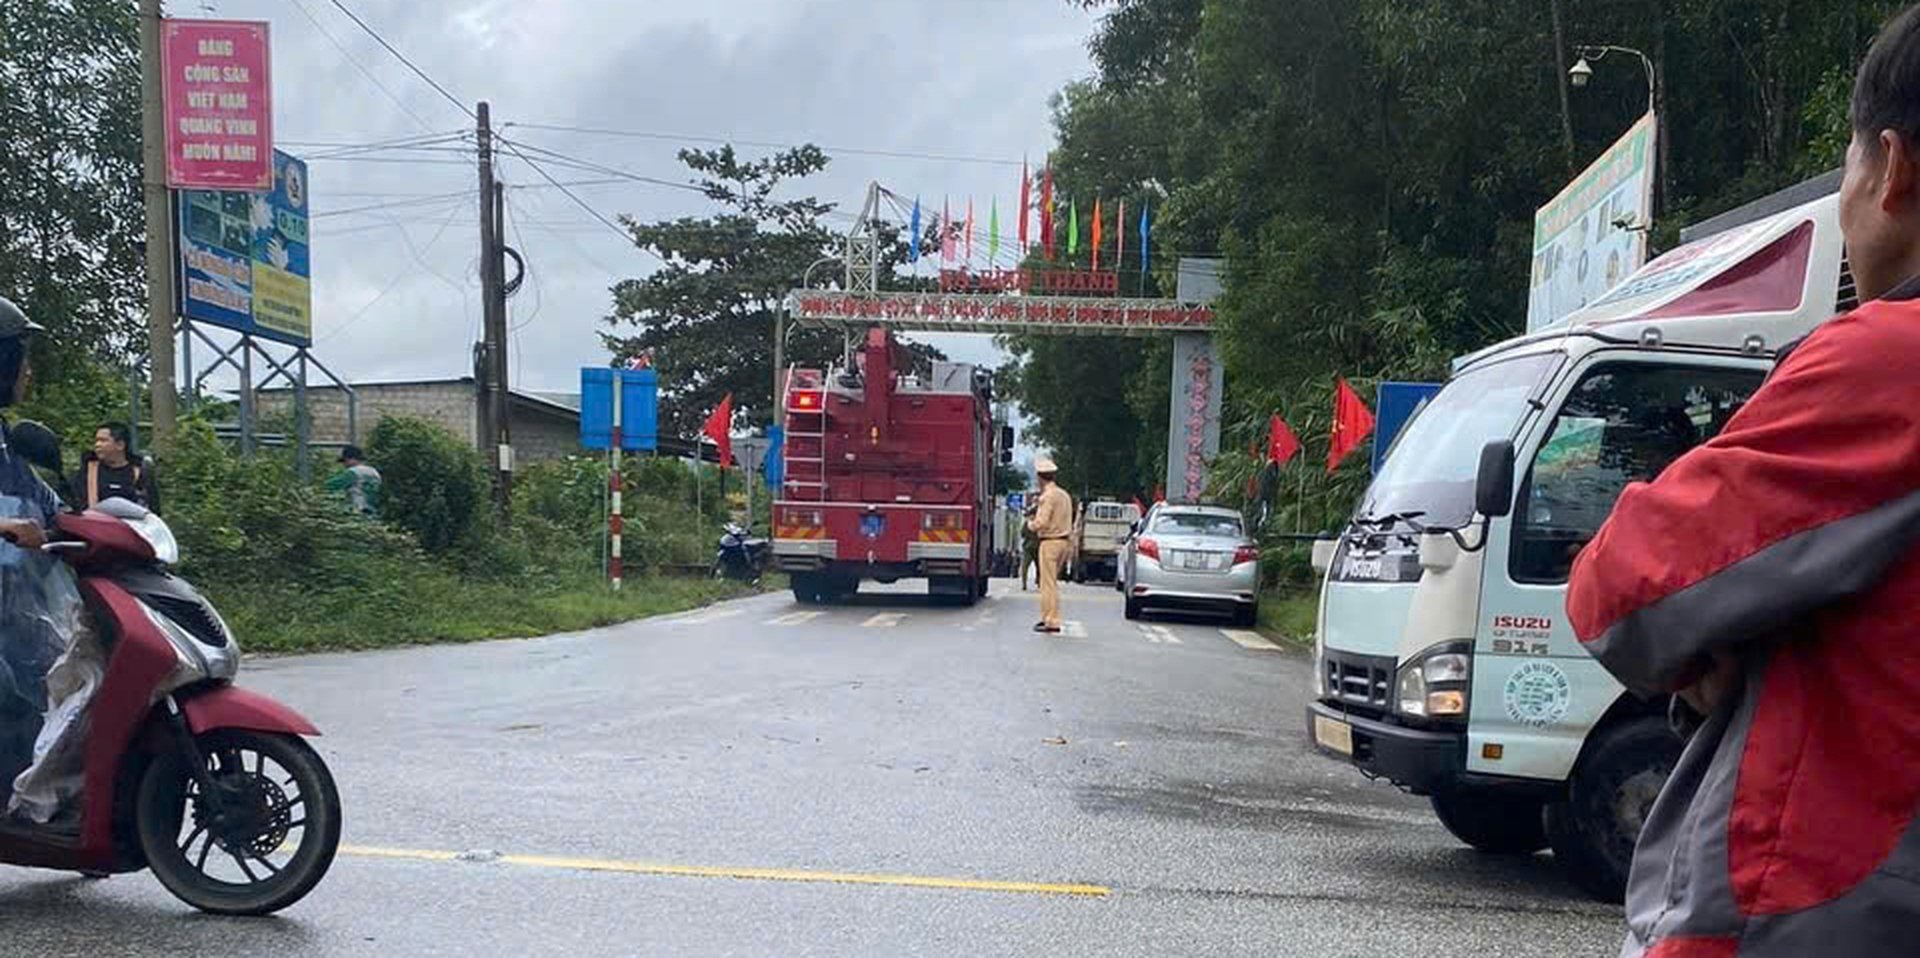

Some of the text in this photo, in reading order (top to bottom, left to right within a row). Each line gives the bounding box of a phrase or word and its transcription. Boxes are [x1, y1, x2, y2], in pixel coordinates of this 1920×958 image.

[184, 63, 250, 84] CỘNG SẢN
[187, 90, 248, 110] VIỆT NAM
[179, 116, 257, 137] QUANG VINH
[1494, 615, 1551, 629] ISUZU
[1493, 639, 1528, 653] 91
